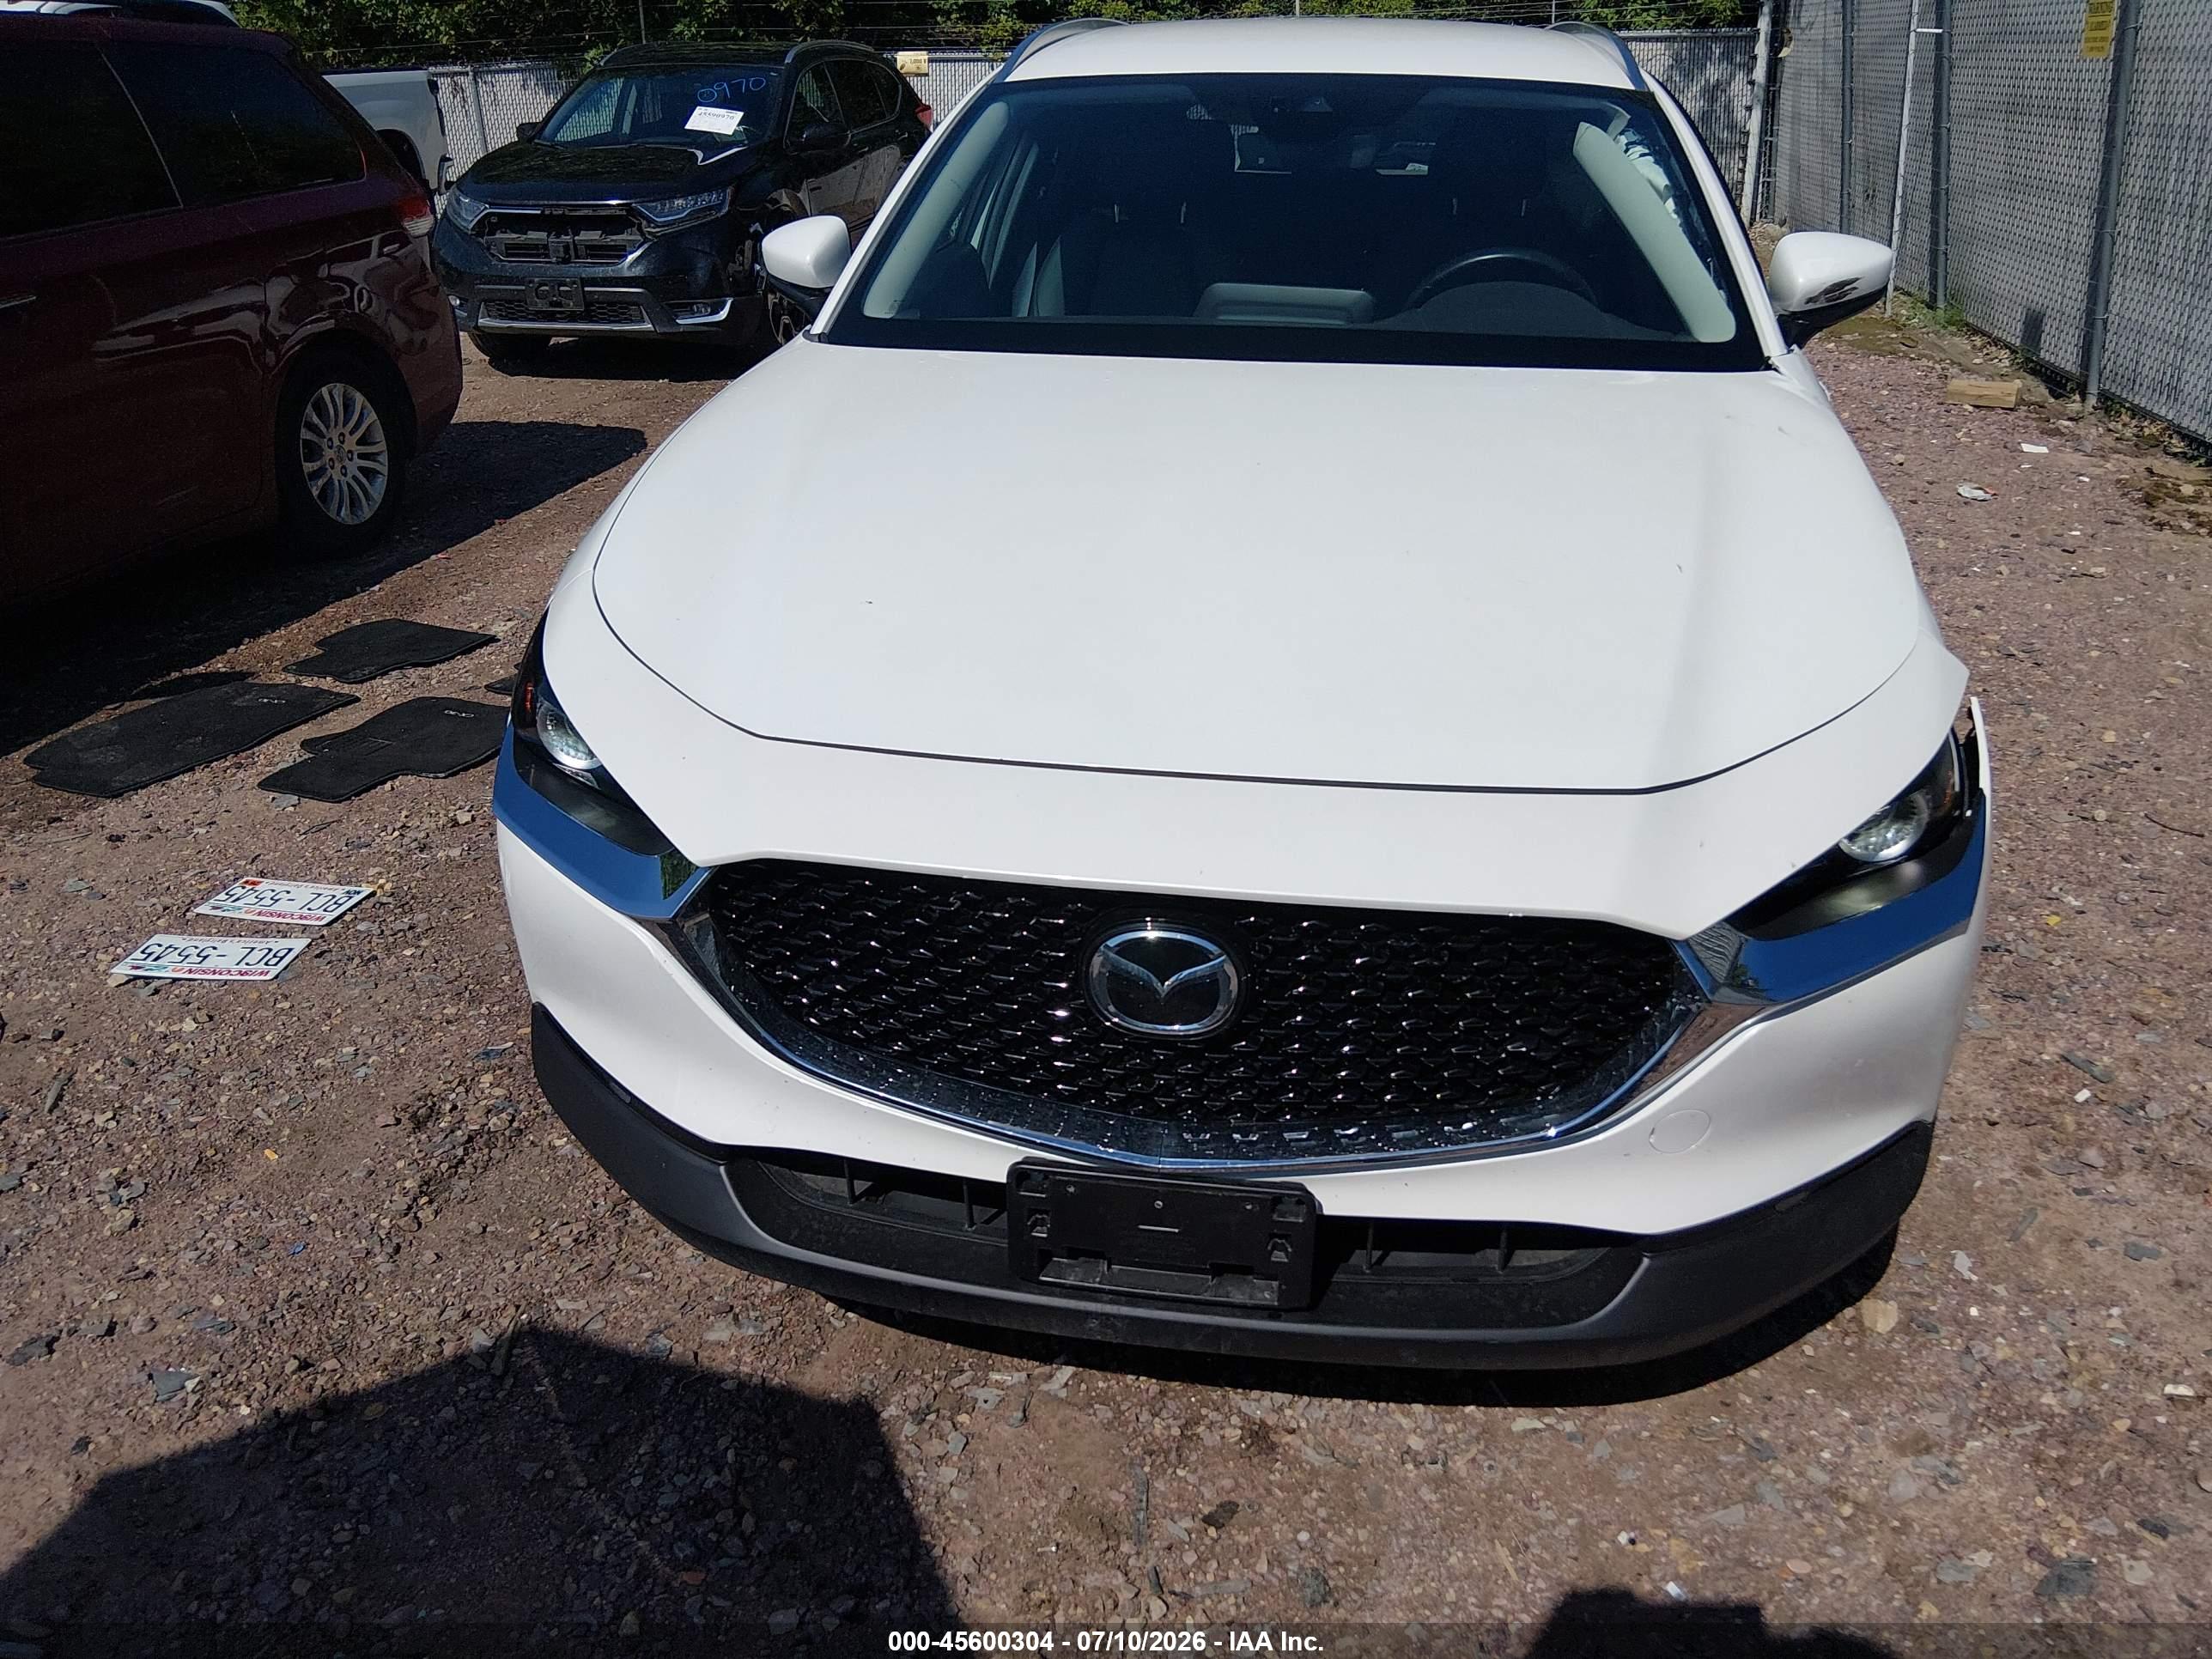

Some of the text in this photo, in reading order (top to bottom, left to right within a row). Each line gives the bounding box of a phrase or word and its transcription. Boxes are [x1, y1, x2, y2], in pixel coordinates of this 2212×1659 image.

[696, 76, 767, 103] 0970
[343, 887, 362, 896] NOV
[252, 910, 327, 922] WISCONSIN
[183, 967, 270, 977] WISCONSIN
